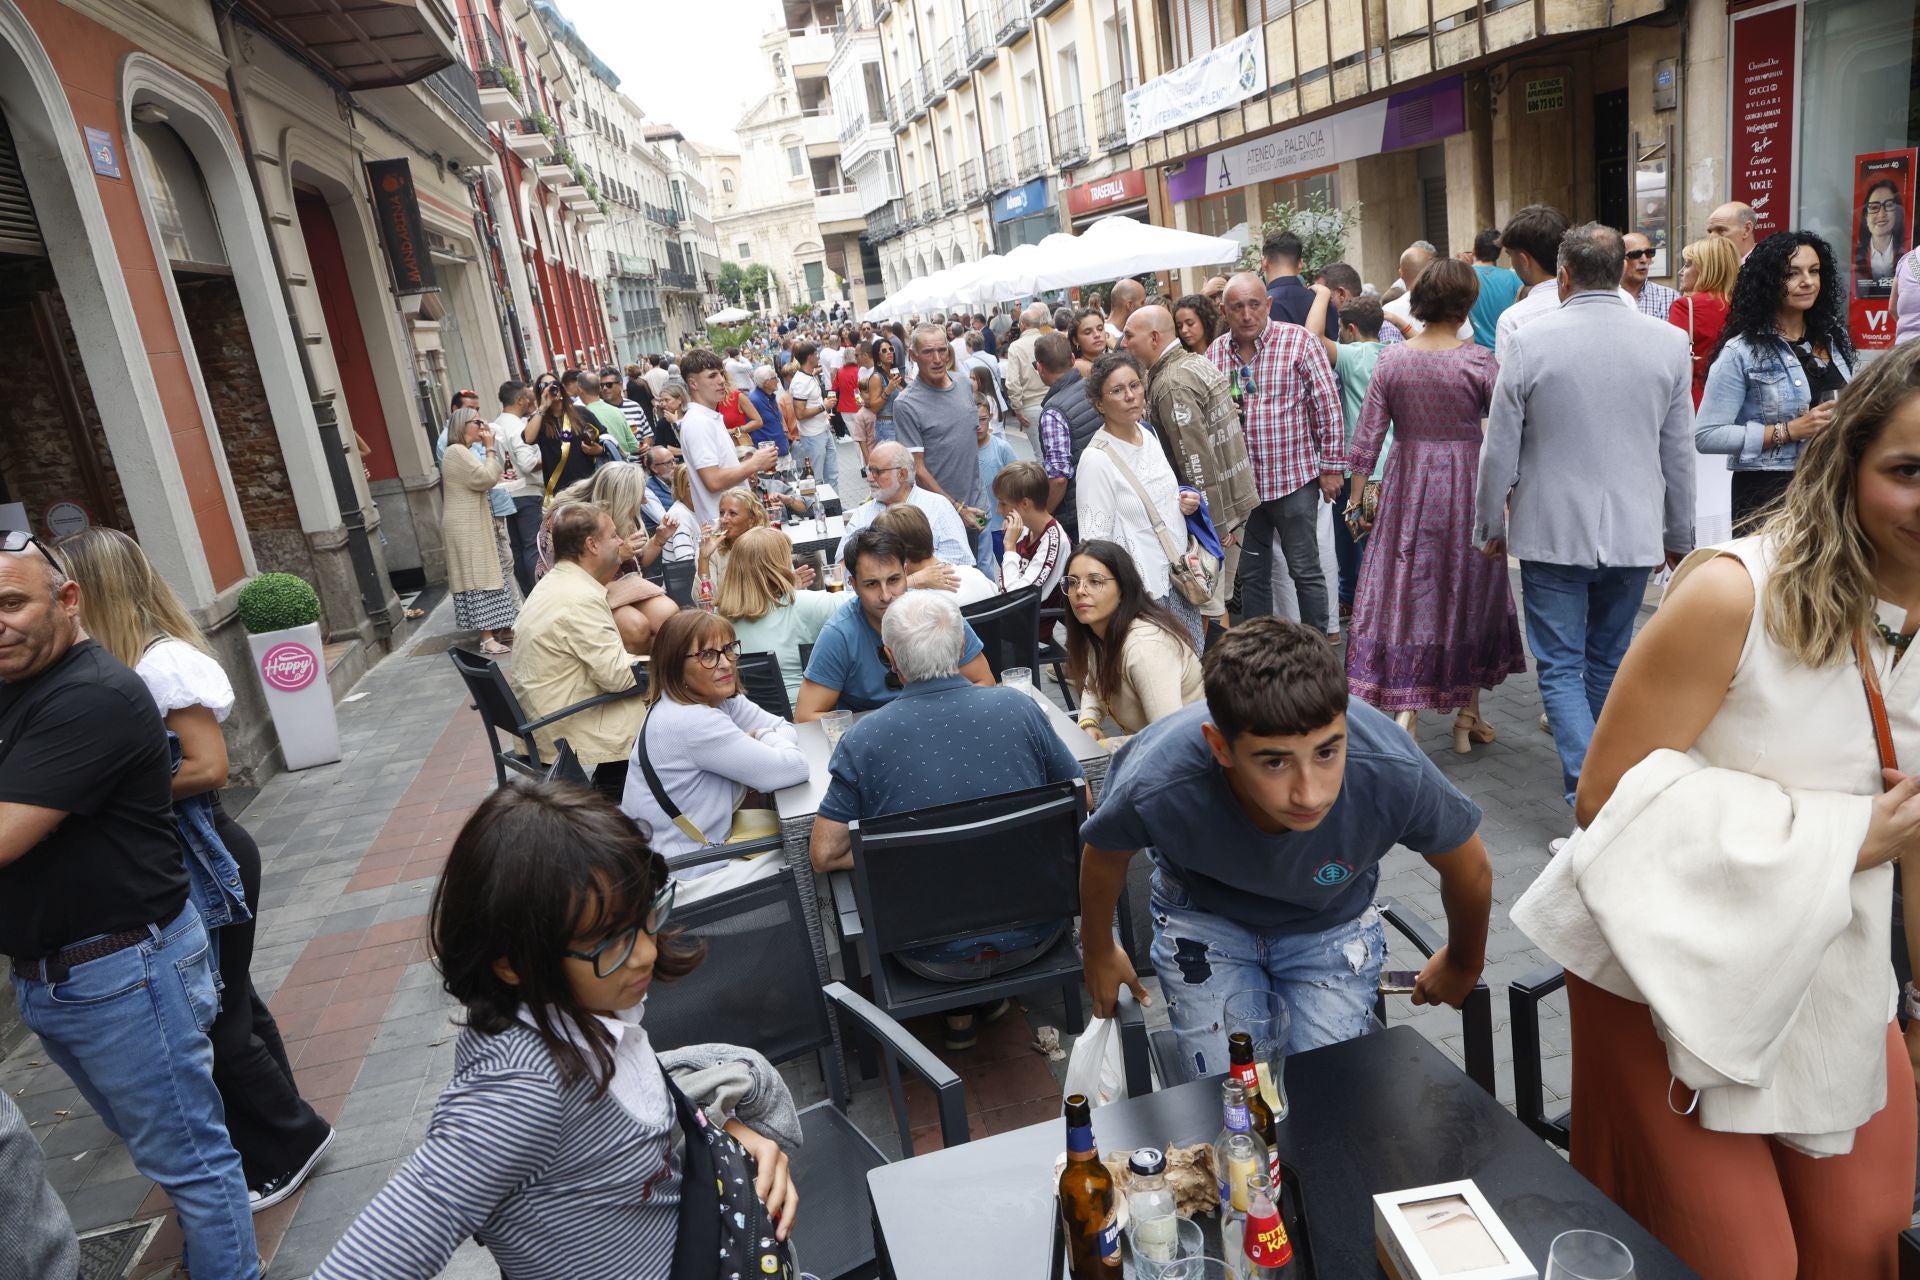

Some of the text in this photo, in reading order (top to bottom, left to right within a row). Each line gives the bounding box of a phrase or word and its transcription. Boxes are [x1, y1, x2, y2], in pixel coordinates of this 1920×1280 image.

[1749, 86, 1770, 96] GUCCI
[1745, 97, 1781, 109] BVLGARI
[1745, 108, 1781, 121] GIORGIO ARMANI
[1247, 143, 1276, 165] ATENEO
[1285, 129, 1325, 154] PALENCIA
[1274, 154, 1297, 169] LITERARIO
[1750, 156, 1773, 166] Cartier
[1219, 151, 1232, 188] A
[1745, 168, 1777, 178] PRADA
[1090, 179, 1125, 201] TRASERILLA
[1749, 180, 1773, 191] VOGUE
[391, 195, 420, 282] MANDARINA
[1862, 333, 1891, 341] VisionLab
[265, 653, 313, 677] Happy
[1267, 1230, 1289, 1253] KAS
